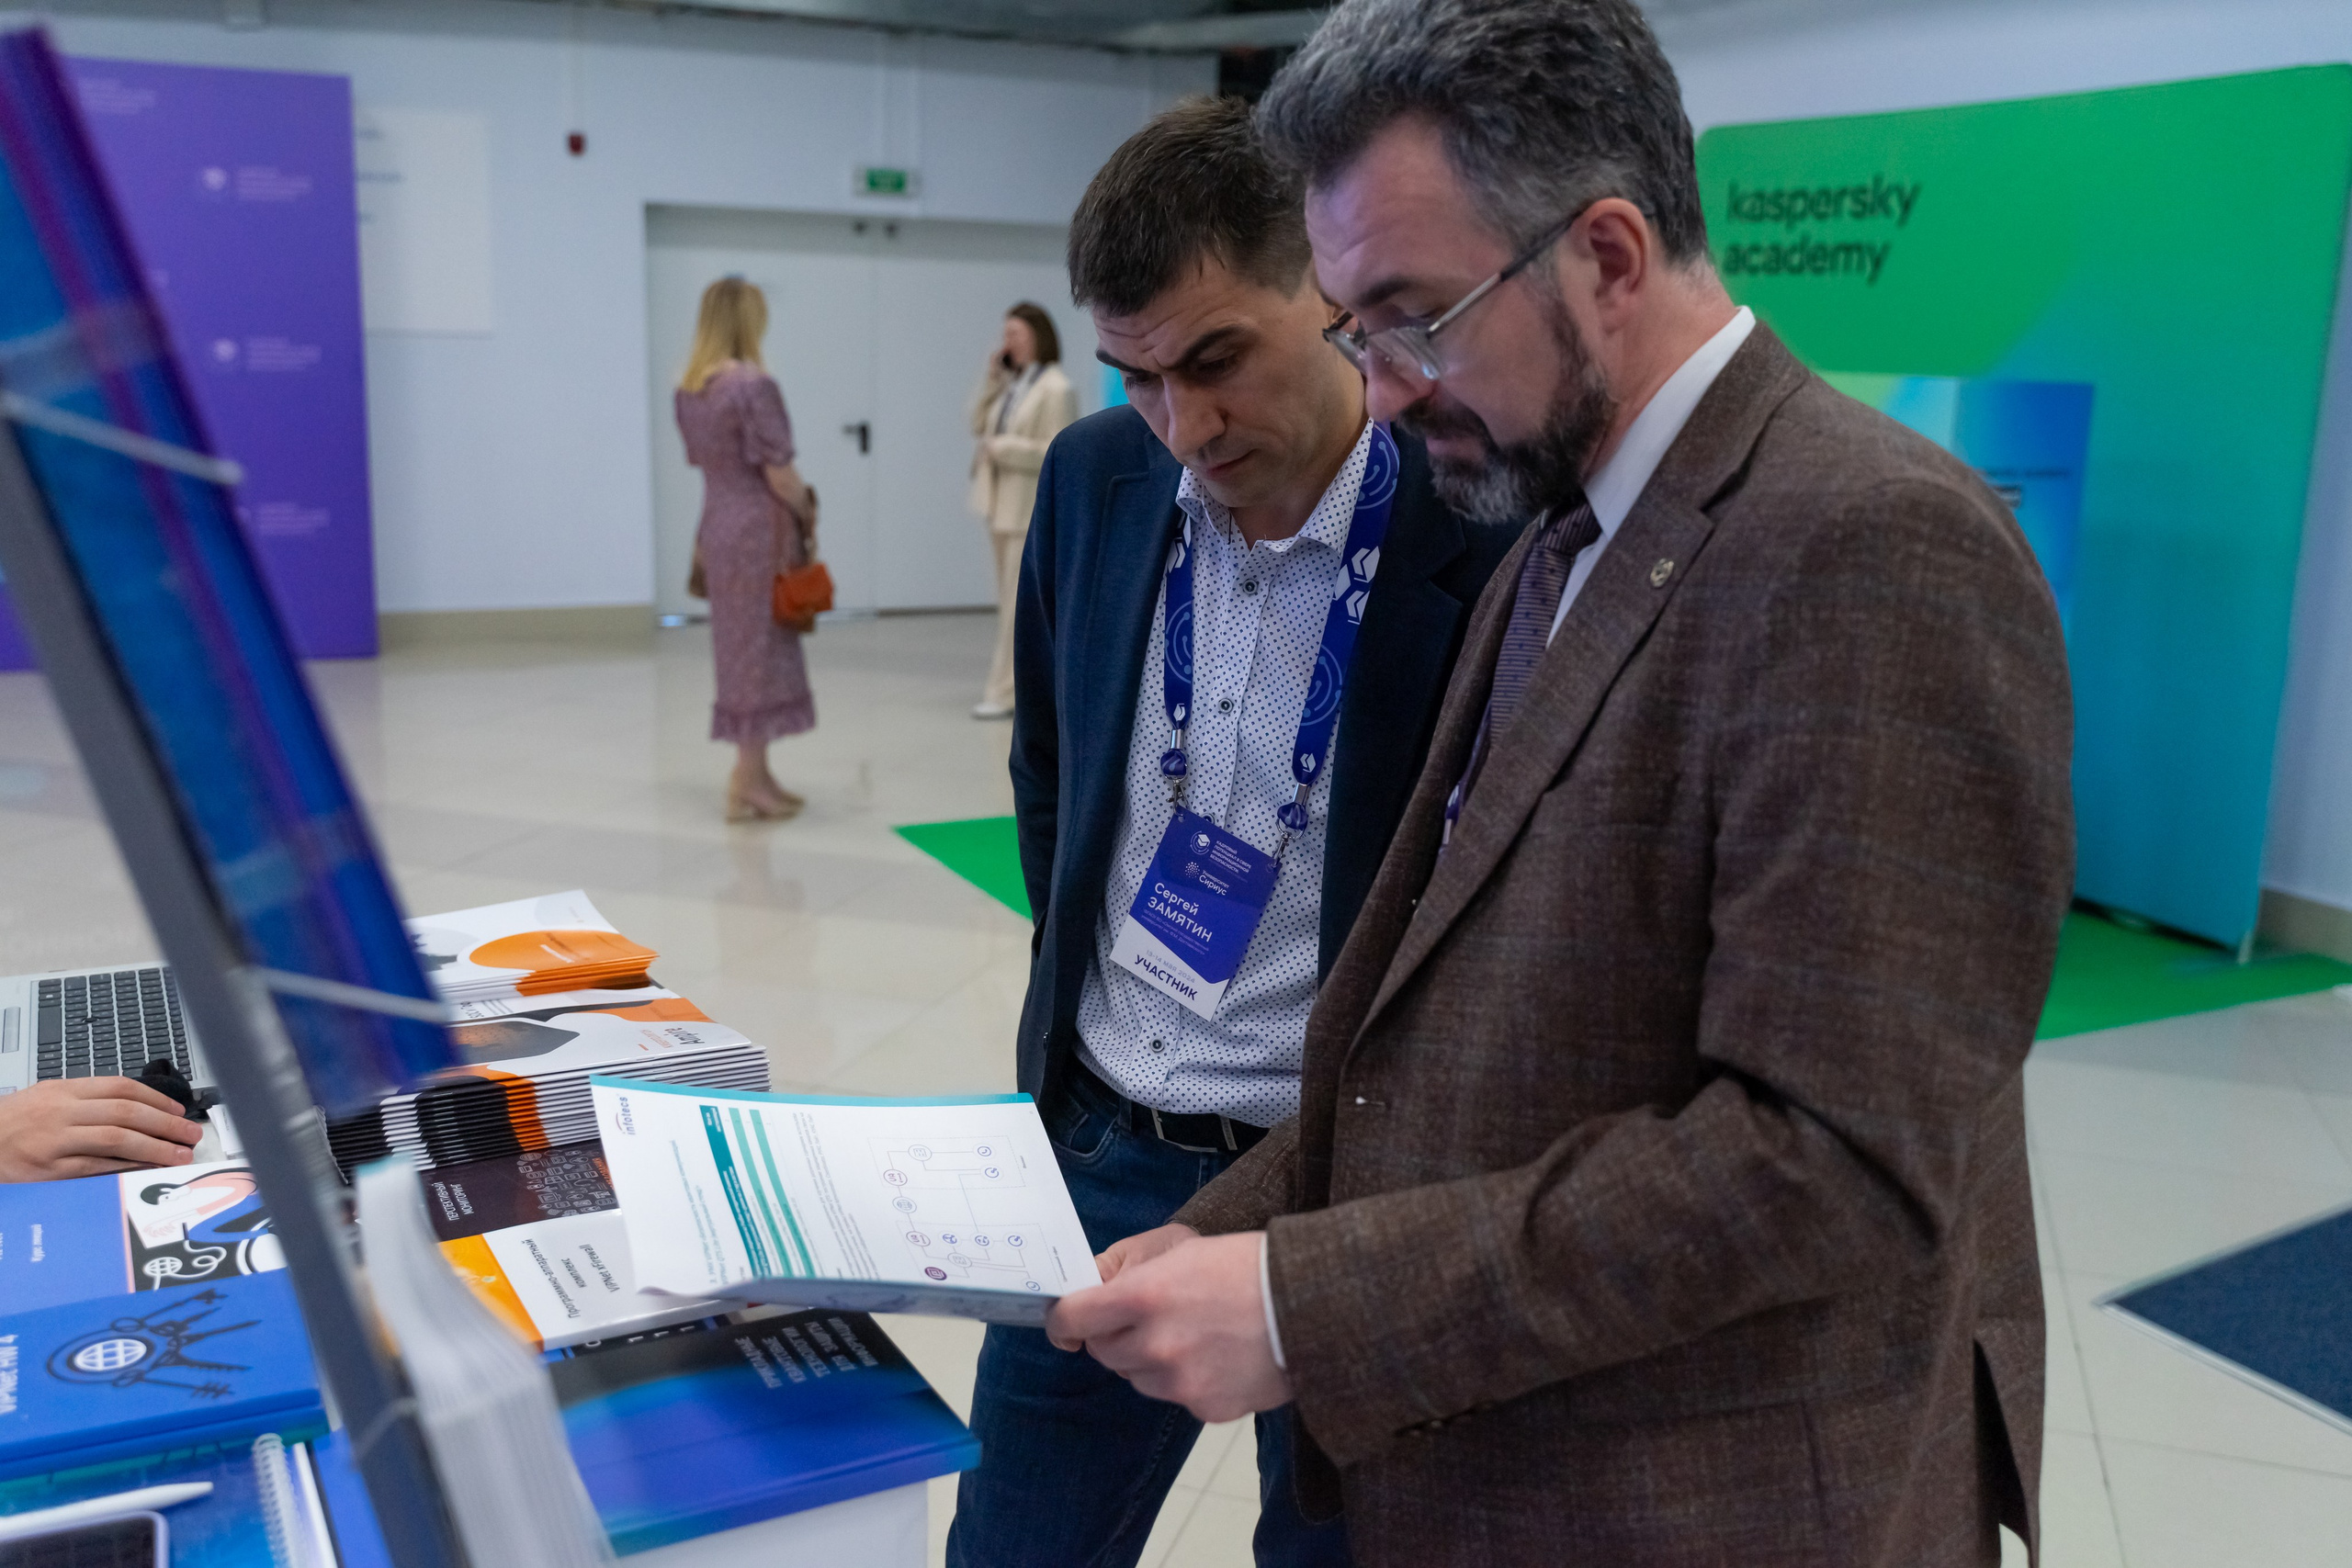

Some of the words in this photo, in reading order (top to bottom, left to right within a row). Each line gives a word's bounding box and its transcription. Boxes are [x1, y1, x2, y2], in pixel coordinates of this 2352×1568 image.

[1726, 172, 1920, 229] kaspersky
[1723, 236, 1890, 286] academy
[1198, 874, 1227, 897] Сириус
[1202, 869, 1229, 889] Университет
[1154, 882, 1199, 916] Сергей
[1146, 896, 1213, 942] ЗАМЯТИН
[1134, 954, 1198, 1001] УЧАСТНИК
[1145, 949, 1162, 963] 13-14
[1162, 960, 1177, 972] мая
[1177, 969, 1196, 984] 2024
[621, 1096, 636, 1135] infotecs
[431, 1181, 459, 1221] ПЕРСПЕКТИВНЫЙ
[450, 1183, 474, 1214] МОНИТОРИНГ
[560, 1258, 587, 1288] комплекс
[578, 1243, 605, 1270] xFirewall
[521, 1237, 581, 1318] Программно-аппаратный
[596, 1270, 620, 1292] ViPNet
[781, 1325, 831, 1378] ТЕХНОЛОГИИ
